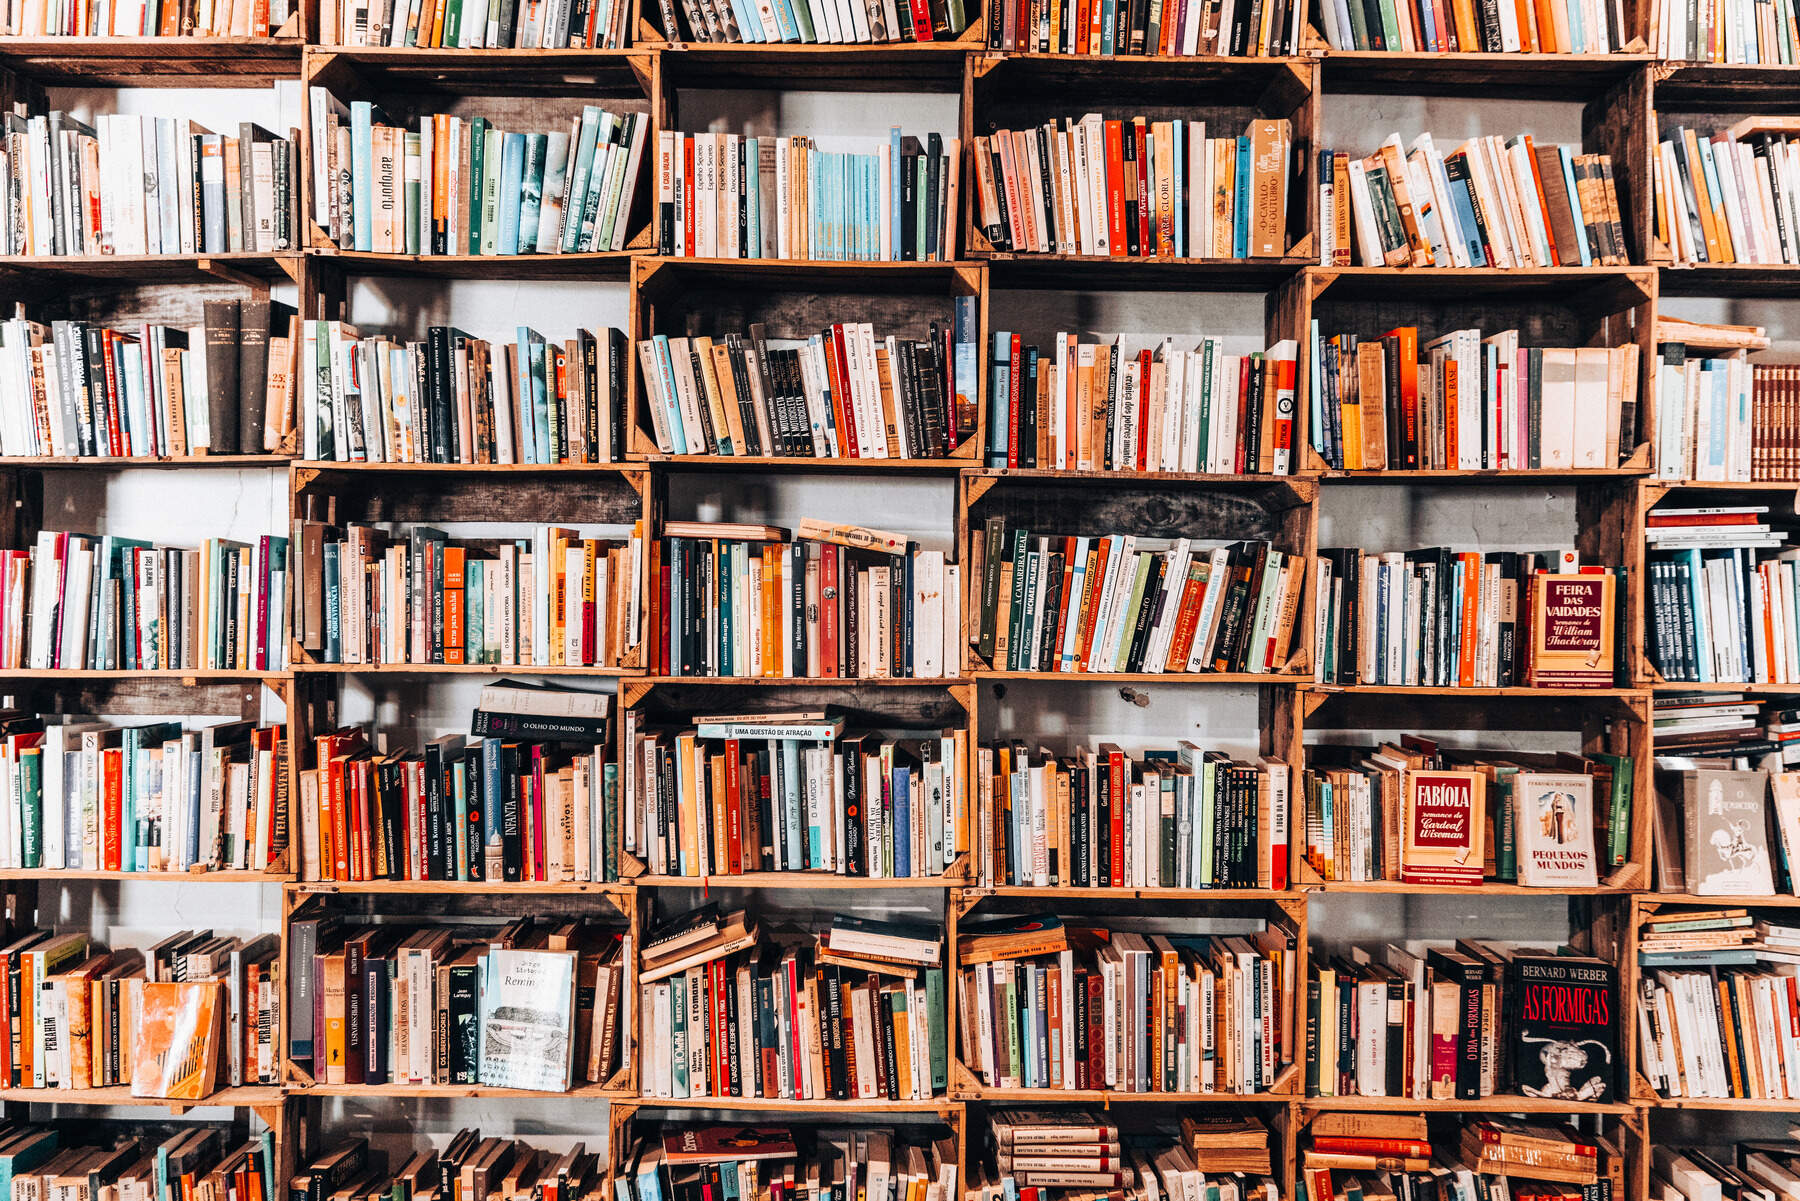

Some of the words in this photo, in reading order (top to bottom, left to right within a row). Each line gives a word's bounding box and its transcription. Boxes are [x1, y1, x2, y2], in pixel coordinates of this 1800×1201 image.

[380, 157, 395, 210] aeroporto
[1260, 184, 1268, 218] CAVALO
[1269, 180, 1278, 220] OUTUBRO
[1269, 223, 1277, 234] DE
[776, 396, 789, 432] MOTOCICLETA
[786, 396, 799, 432] MOTOCICLETA
[796, 396, 809, 431] MOTOCICLETA
[1124, 401, 1134, 414] dos
[1122, 416, 1133, 438] pobres
[1123, 440, 1131, 465] amantes
[1019, 534, 1027, 553] REAL
[1015, 555, 1025, 598] CAMAREIRA
[1029, 559, 1038, 584] PALMER
[1026, 586, 1036, 615] MICHAEL
[1556, 585, 1592, 595] FEIRA
[1564, 597, 1583, 605] DAS
[1546, 607, 1600, 617] VAIDADES
[1547, 636, 1600, 648] Thackeray
[1553, 625, 1592, 636] William
[277, 759, 288, 813] ENVOLVENTE
[1418, 784, 1470, 807] FABÍOLA
[276, 816, 286, 835] TEIA
[504, 801, 517, 836] INFANTA
[1421, 818, 1464, 831] Cardeal
[1504, 794, 1513, 843] EMBAIXADOR
[1420, 830, 1464, 839] Wiseman
[1532, 850, 1588, 860] PEQUENOS
[1537, 861, 1585, 870] MUNDOS
[1523, 966, 1565, 979] BERNARD
[1570, 968, 1608, 981] WERBER
[1468, 989, 1479, 1028] FORMIGAS
[1523, 985, 1539, 1020] AS
[1541, 986, 1608, 1026] FORMIGAS
[44, 1017, 57, 1051] PERAHIM
[258, 1010, 270, 1044] PERAHIM
[1307, 1018, 1315, 1062] LAMIA
[1467, 1040, 1478, 1053] DIA
[730, 1055, 738, 1083] EVASÕES
[682, 1131, 697, 1152] Erros
